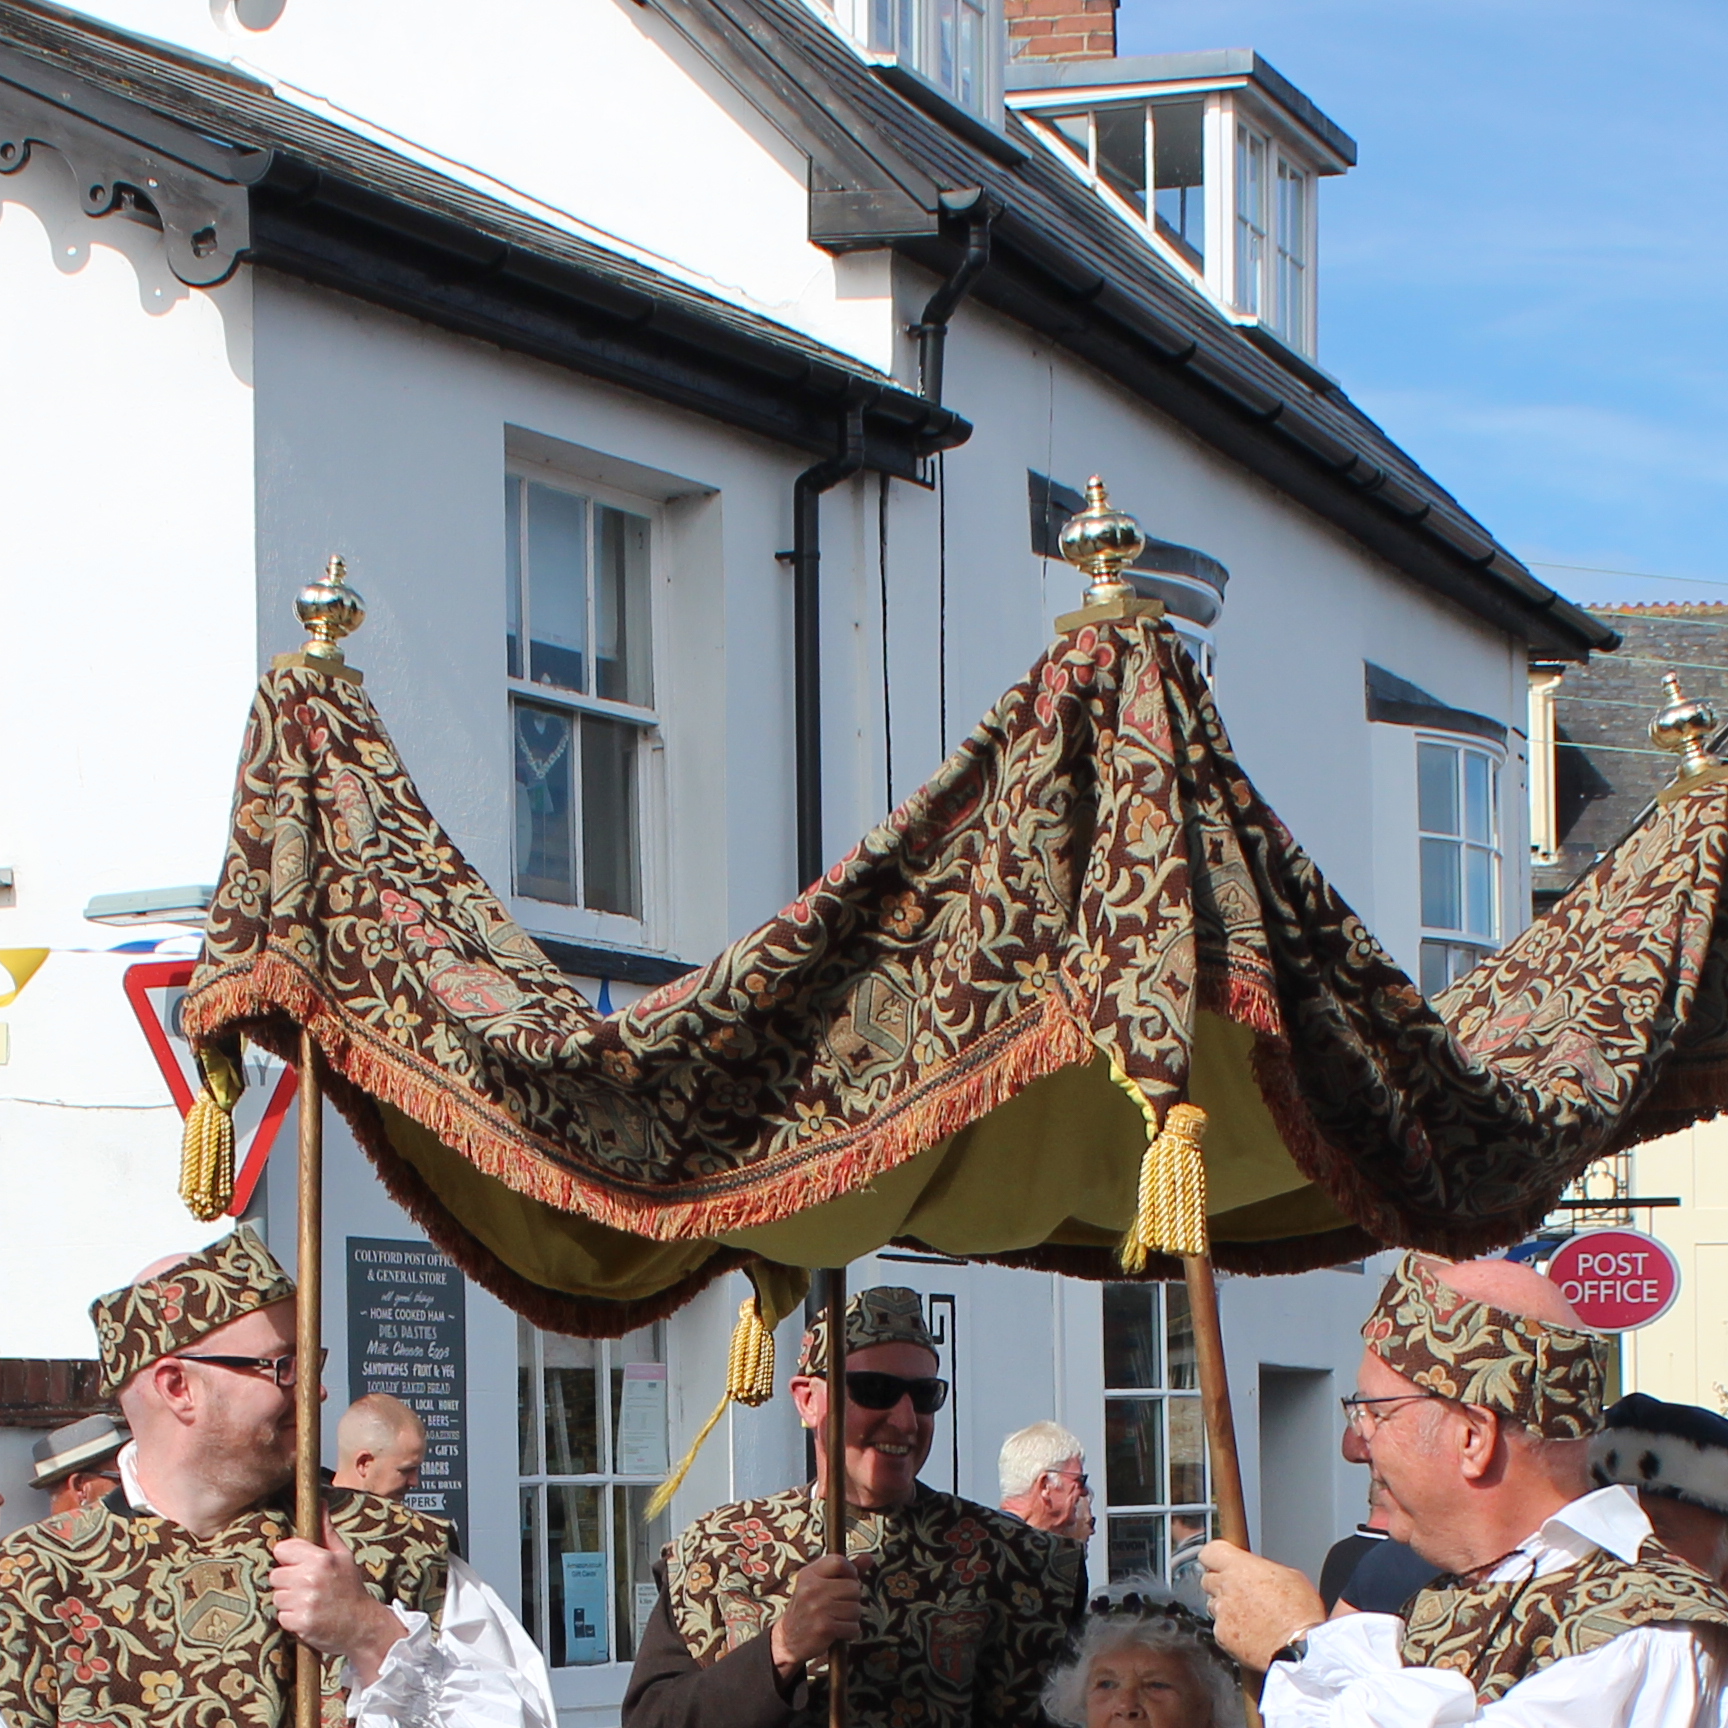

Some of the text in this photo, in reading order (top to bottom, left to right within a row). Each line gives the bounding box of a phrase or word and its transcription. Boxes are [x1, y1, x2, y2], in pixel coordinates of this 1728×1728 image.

[354, 1249, 457, 1268] COLYFORD POST OFFIC
[1577, 1252, 1650, 1276] POST
[367, 1268, 447, 1285] & GENERAL STORE
[1560, 1279, 1659, 1304] OFFICE
[370, 1308, 445, 1322] HOME COOKED HAM
[378, 1324, 437, 1340] PIES PASTIES
[366, 1340, 389, 1356] Milk
[427, 1341, 450, 1360] Eggs
[362, 1361, 409, 1377] SANDWICHES
[412, 1363, 432, 1377] FRUIT
[441, 1364, 455, 1379] VEG
[367, 1381, 450, 1395] LOCALLY BAKED BREAD
[415, 1399, 434, 1410] LOCAL
[438, 1399, 459, 1411] HONEY
[427, 1415, 449, 1427] BEERS
[425, 1430, 460, 1440] AGAZINES
[434, 1444, 459, 1456] GIFTS
[420, 1461, 450, 1476] SNACKS
[421, 1480, 462, 1490] VEG BOXES
